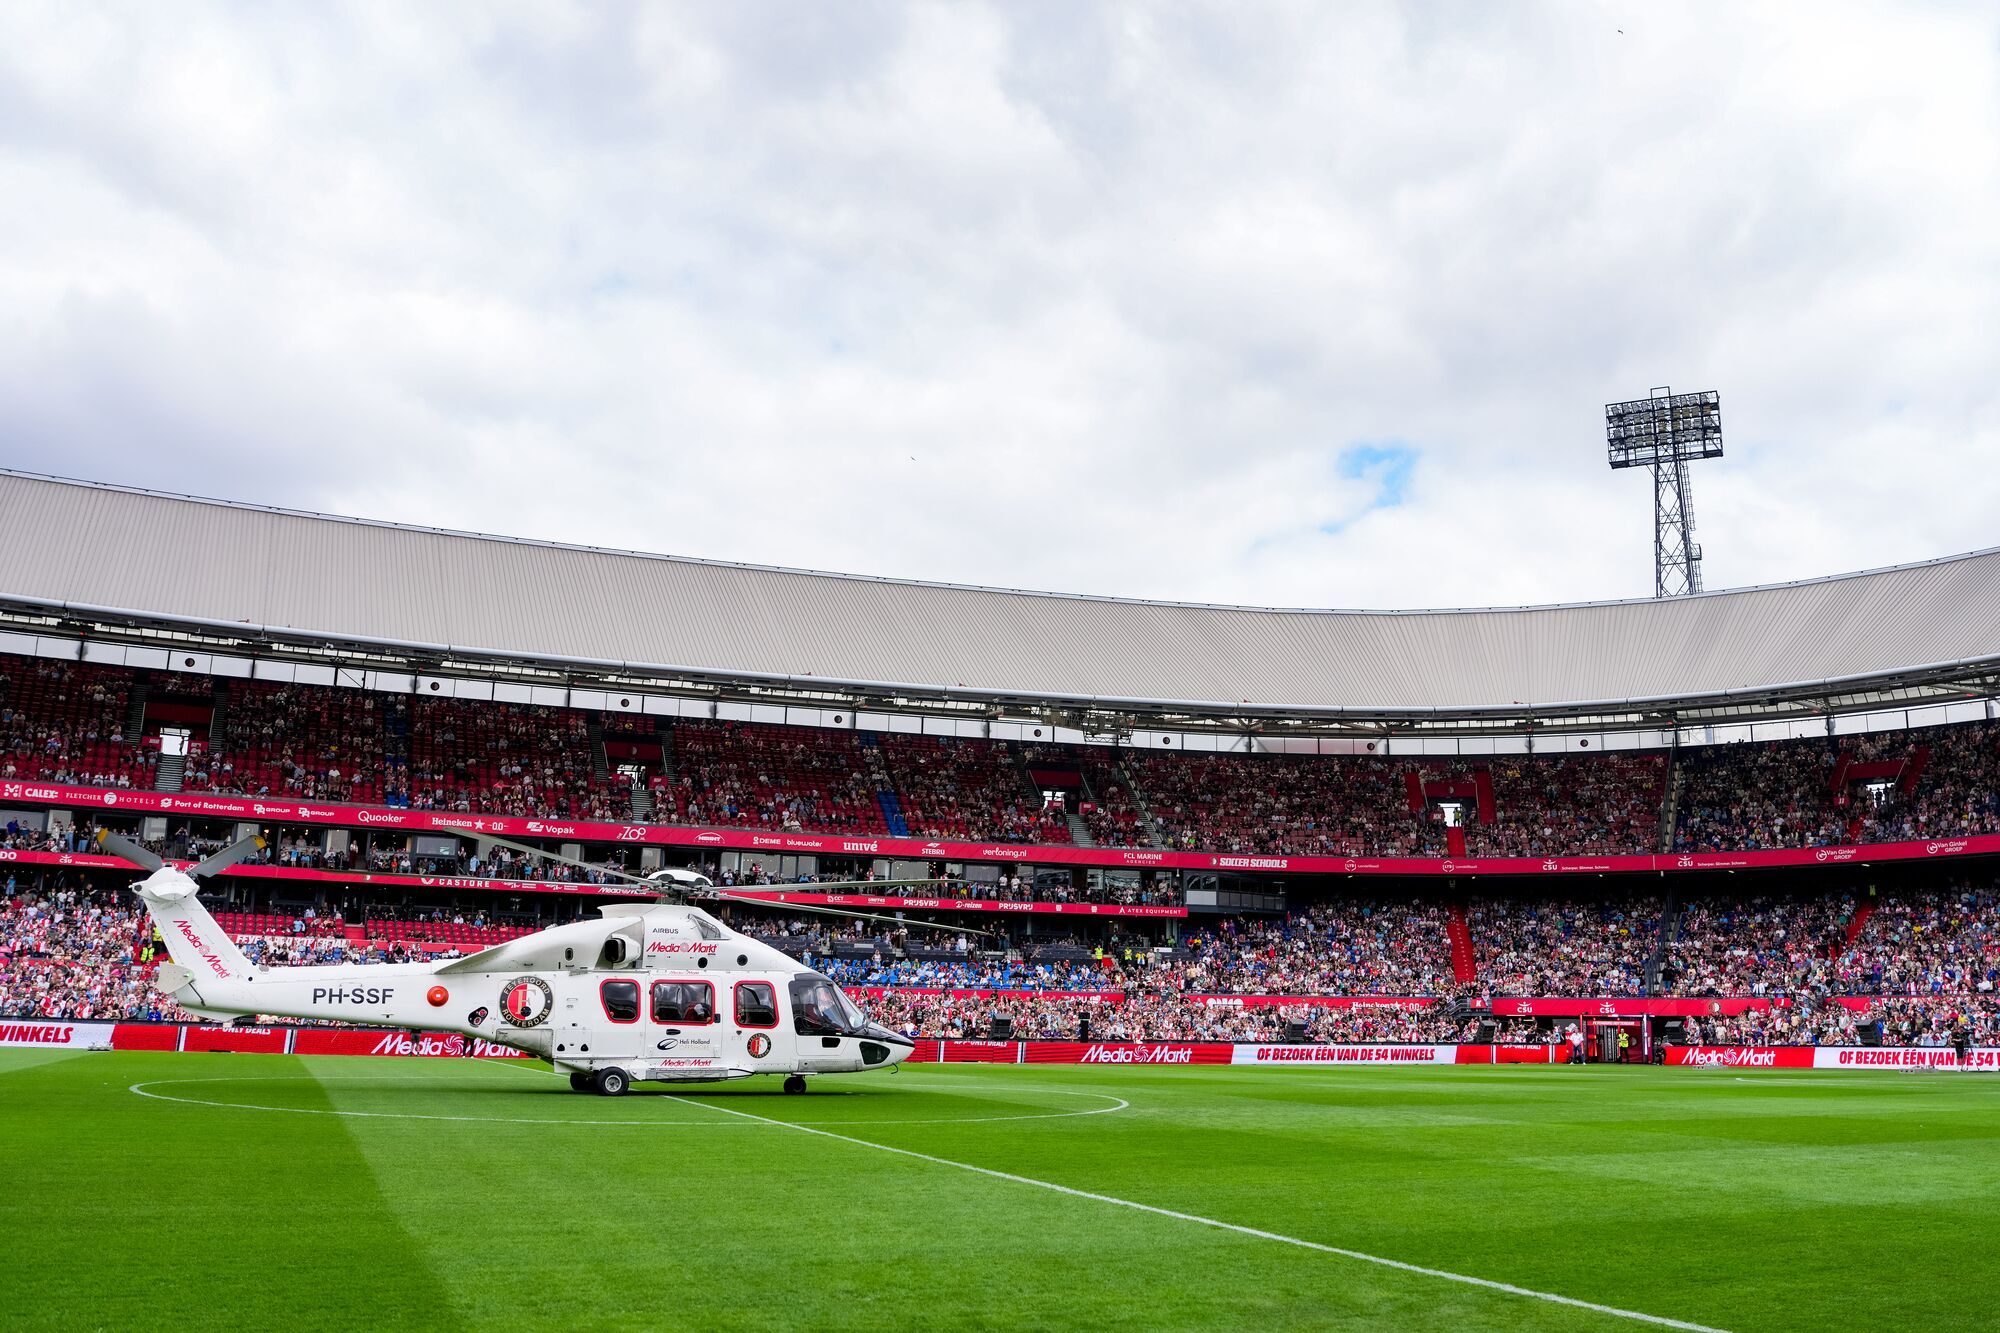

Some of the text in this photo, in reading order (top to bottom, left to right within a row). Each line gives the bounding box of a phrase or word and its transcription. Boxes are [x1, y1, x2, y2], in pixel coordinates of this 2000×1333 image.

[66, 792, 101, 801] FLETCHER
[203, 803, 244, 811] Rotterdam
[358, 811, 404, 822] Quooker
[432, 817, 472, 827] Heineken
[545, 825, 575, 834] Vopak
[787, 839, 822, 847] bluewater
[843, 840, 878, 851] univé
[1220, 857, 1287, 868] SOCCER SCHOOLS
[439, 879, 490, 888] CASTORE
[173, 920, 231, 979] Media Markt
[646, 941, 718, 953] Media Markt
[503, 977, 550, 995] FEYENOORD
[313, 988, 394, 1004] PH-SSF
[501, 1008, 549, 1027] ROTTERDAM
[1080, 1045, 1192, 1062] Media Markt
[1257, 1046, 1435, 1061] OF BEZOEK ÉÉN VAN DE 54 WINKELS
[1682, 1048, 1775, 1065] Media Markt
[1839, 1051, 1854, 1064] OF
[1855, 1051, 1904, 1065] BEZOEK
[1903, 1049, 1926, 1065] ÉÉN
[1929, 1051, 1956, 1066] VAN
[1977, 1052, 1994, 1066] 54
[661, 1059, 711, 1067] Media Markt
